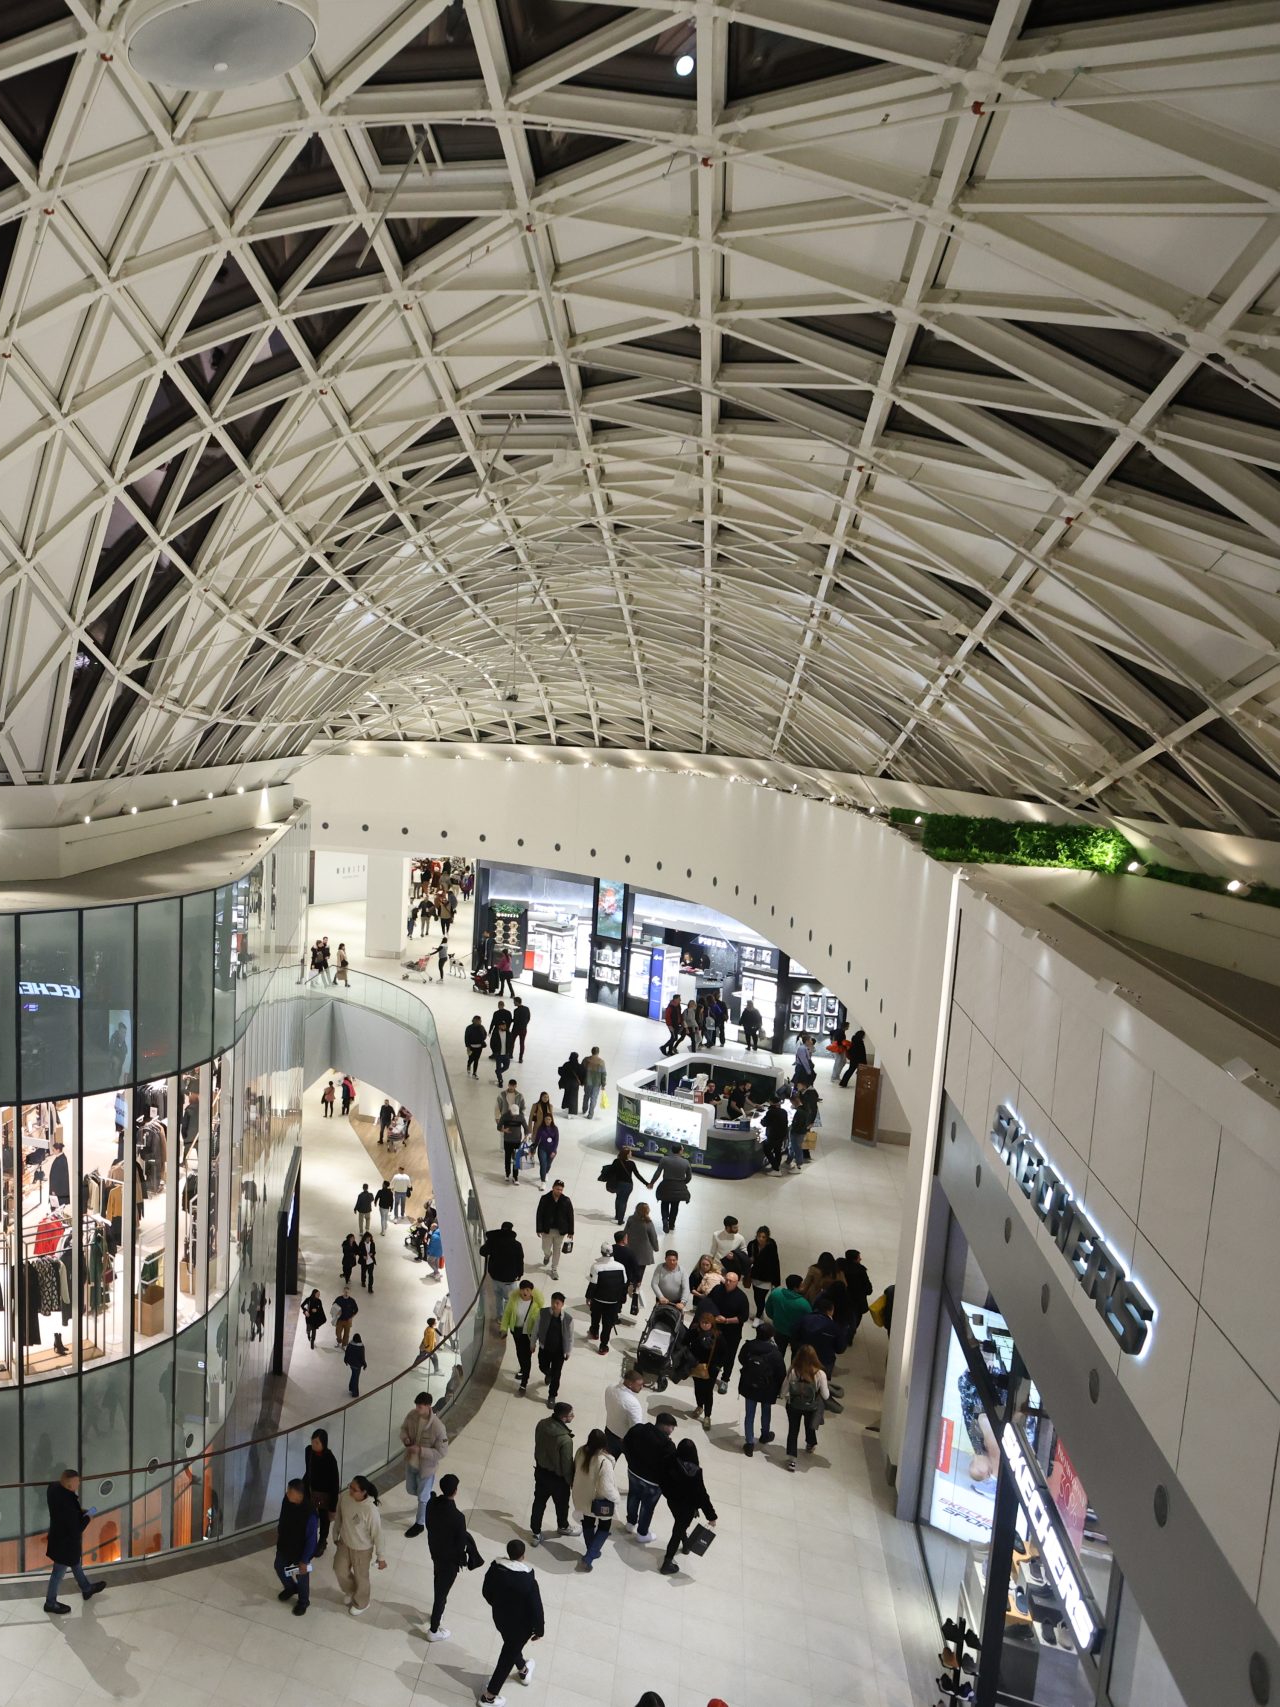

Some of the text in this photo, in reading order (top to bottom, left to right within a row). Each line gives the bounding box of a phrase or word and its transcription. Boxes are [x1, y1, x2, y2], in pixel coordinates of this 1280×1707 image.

[990, 1103, 1155, 1356] SKECHERS
[938, 1497, 993, 1524] SKECHE
[942, 1507, 992, 1531] SPOR
[1002, 1423, 1094, 1649] SKECHERS
